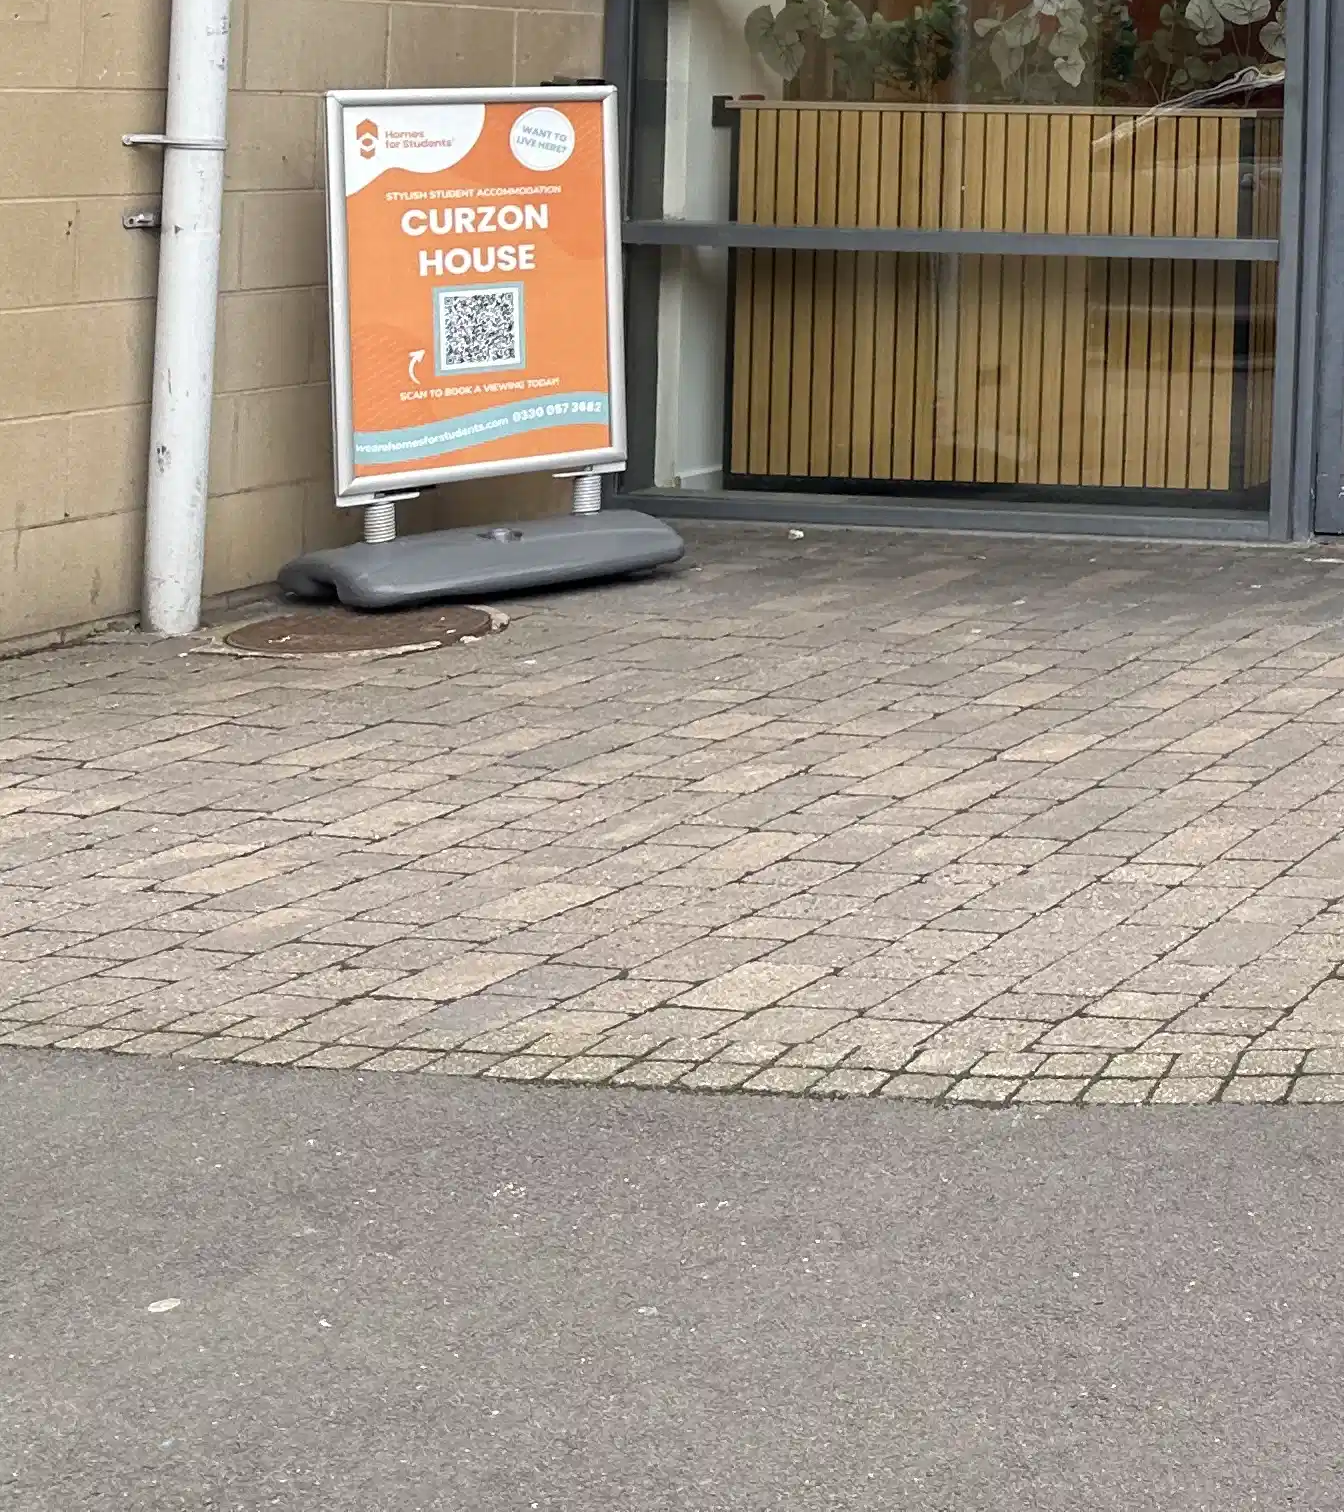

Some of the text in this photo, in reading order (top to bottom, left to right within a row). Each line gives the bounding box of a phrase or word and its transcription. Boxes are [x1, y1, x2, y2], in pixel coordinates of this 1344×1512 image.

[385, 130, 425, 139] Homes
[516, 135, 537, 148] LIVE
[522, 124, 568, 143] WANT TO
[385, 139, 401, 148] for
[386, 185, 562, 201] STYLISH STUDENT ACCOMMODATION
[401, 203, 549, 236] CURZON
[418, 244, 536, 277] HOUSE
[399, 390, 428, 402] SCAN
[429, 388, 443, 398] TO
[444, 385, 473, 397] BOOK
[474, 384, 483, 393] A
[483, 381, 525, 392] VIEWING
[512, 406, 544, 423] 0330
